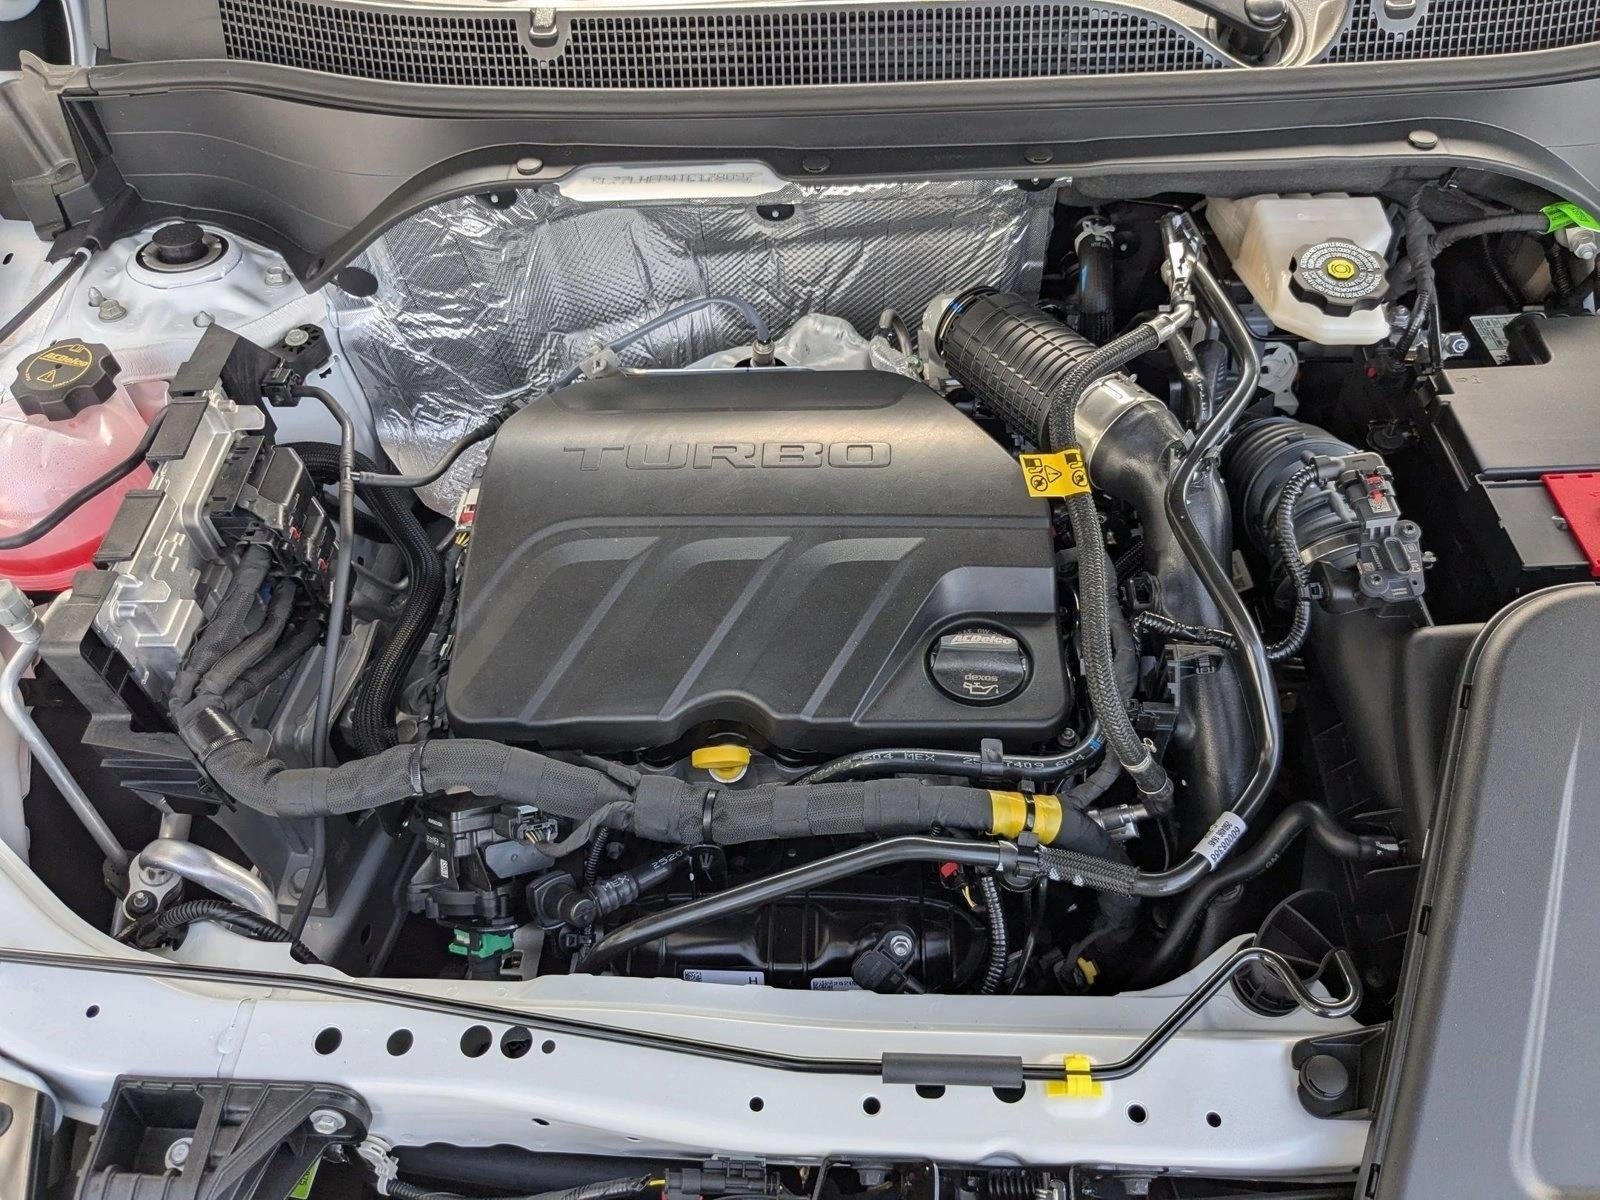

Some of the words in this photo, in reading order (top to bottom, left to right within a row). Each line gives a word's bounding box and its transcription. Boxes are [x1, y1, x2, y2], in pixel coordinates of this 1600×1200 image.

[40, 352, 89, 367] ACDelco
[563, 442, 892, 471] TURBO
[950, 634, 1013, 644] ACDelco
[964, 673, 998, 682] dexos
[904, 752, 936, 761] MEX
[601, 874, 630, 891] MEX
